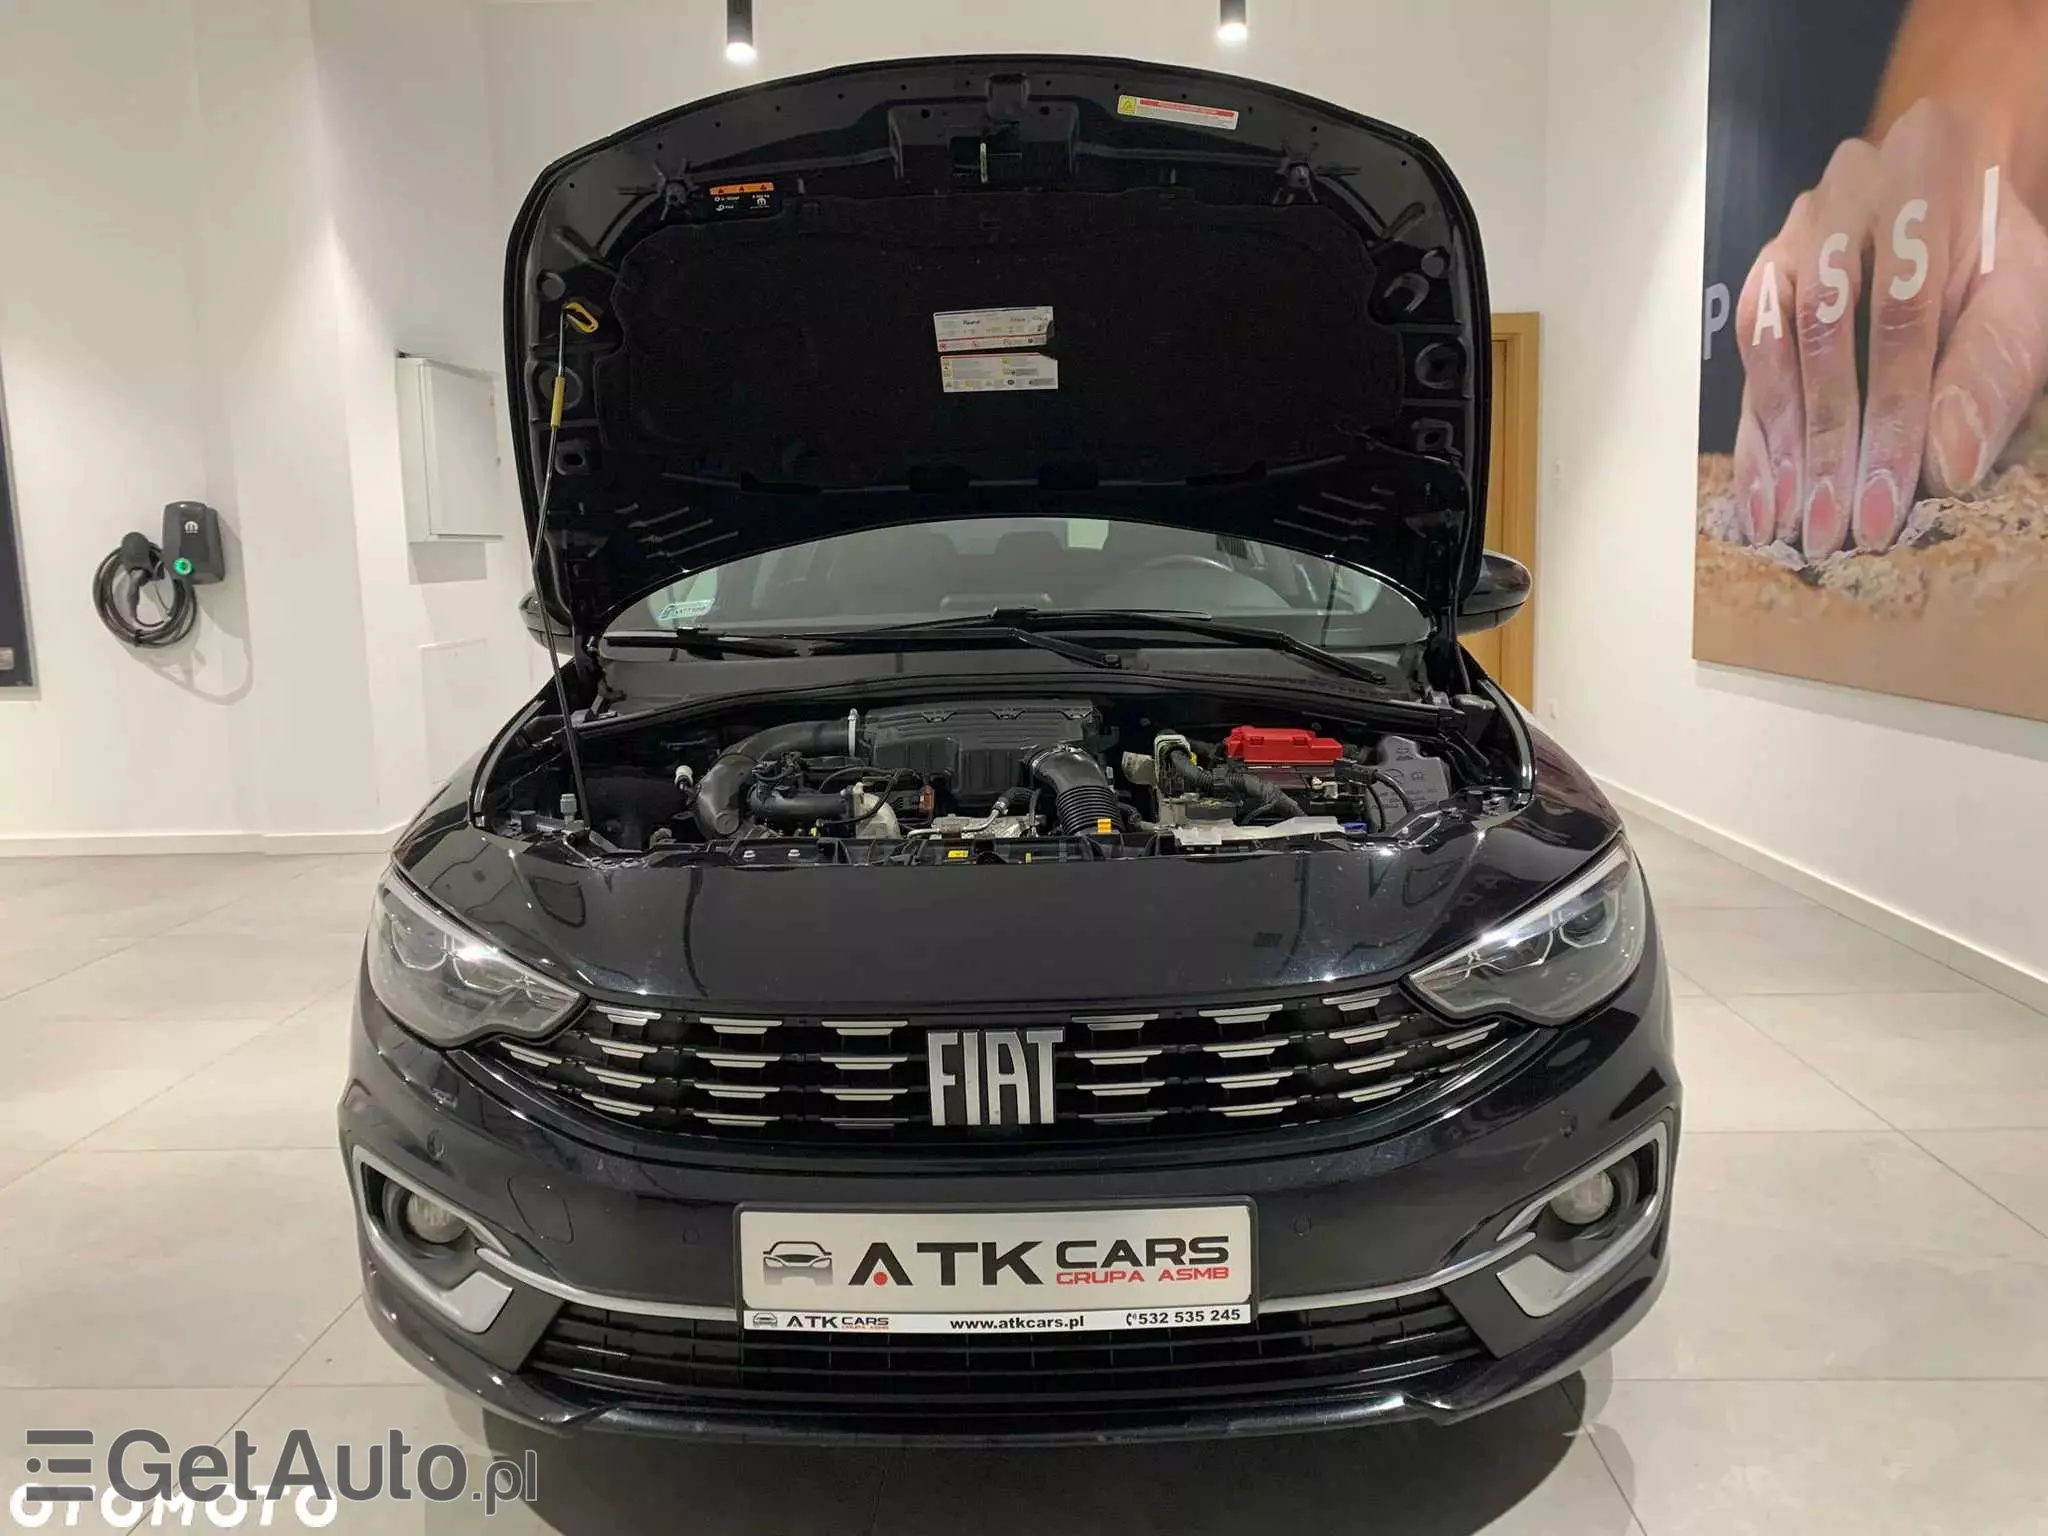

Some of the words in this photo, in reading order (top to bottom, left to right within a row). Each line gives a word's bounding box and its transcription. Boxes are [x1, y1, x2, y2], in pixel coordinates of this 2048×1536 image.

[928, 1031, 1064, 1126] FIAT
[848, 1240, 1044, 1286] ATK
[1056, 1235, 1230, 1268] CARS
[1056, 1268, 1146, 1285] GRUPA
[1158, 1266, 1230, 1282] ASMB
[787, 1315, 838, 1329] ATK
[842, 1317, 889, 1326] CARS
[950, 1315, 1085, 1330] www.atkcars.pl
[1138, 1312, 1172, 1325] 532
[1176, 1311, 1207, 1323] 535
[1210, 1309, 1241, 1322] 245
